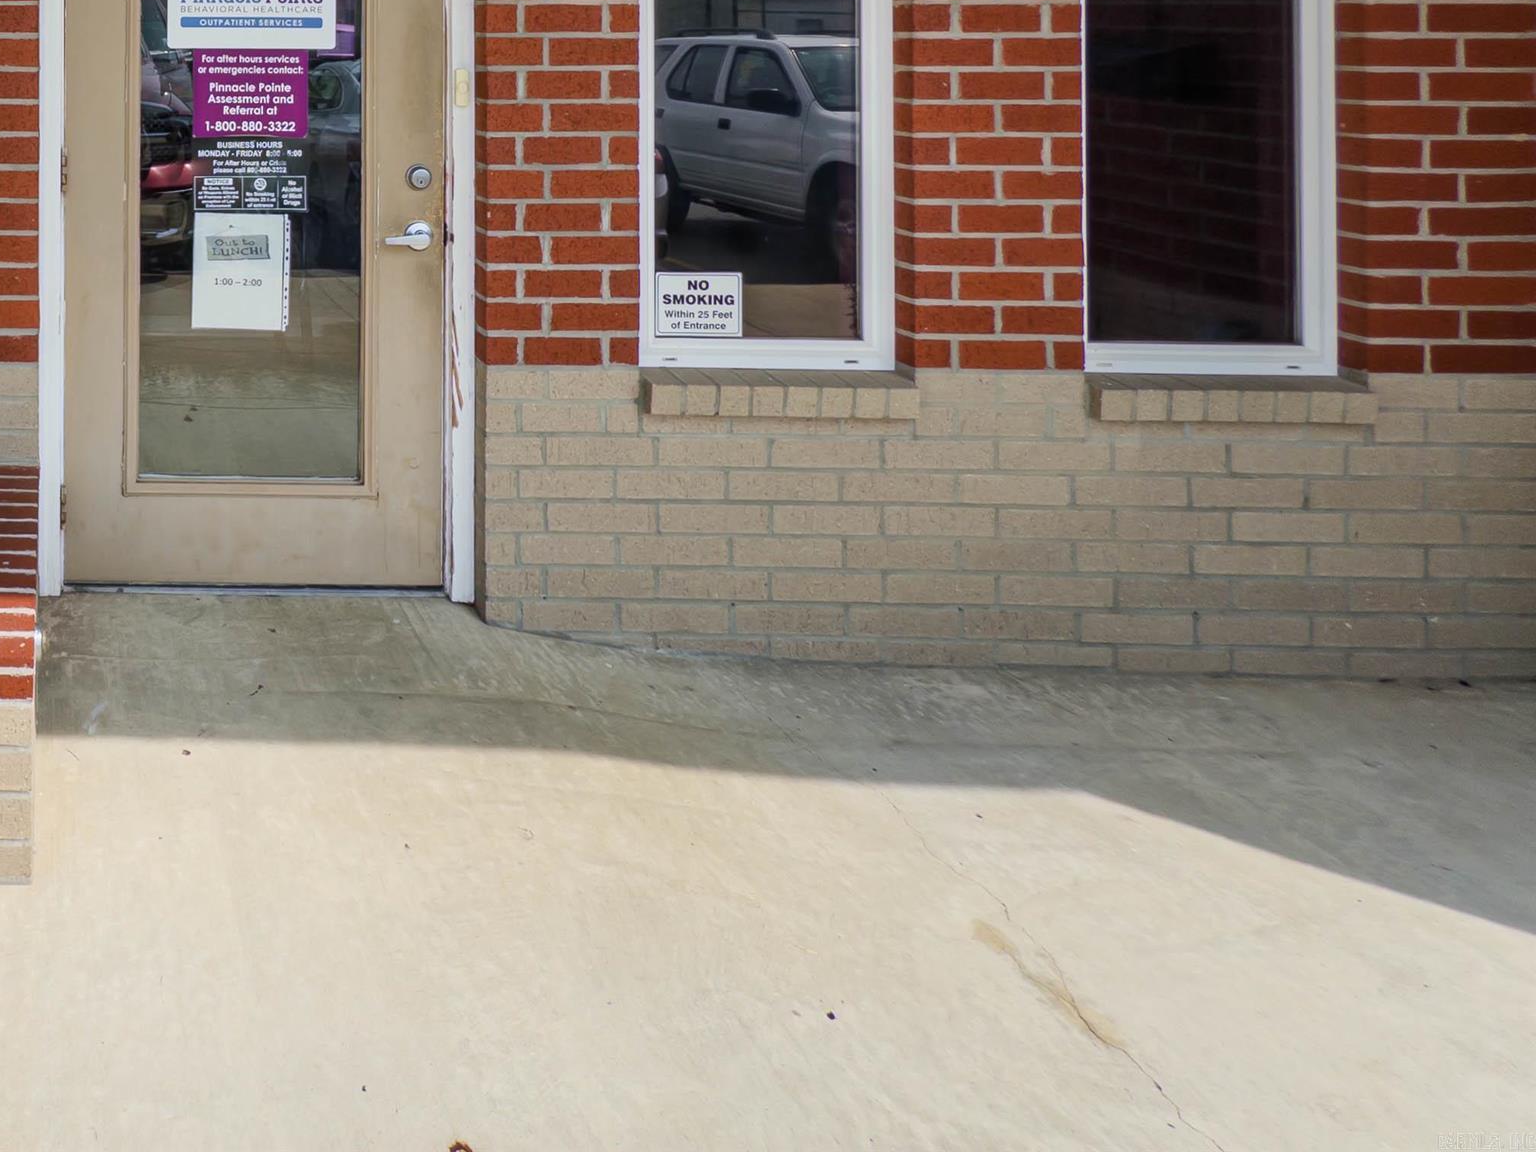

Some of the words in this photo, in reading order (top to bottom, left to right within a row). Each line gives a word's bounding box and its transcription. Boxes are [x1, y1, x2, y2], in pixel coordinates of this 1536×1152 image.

[180, 5, 248, 13] BEHAVIORAL
[253, 6, 323, 14] HEALTHCARE
[201, 54, 214, 63] For
[216, 54, 238, 63] after
[239, 55, 263, 63] hours
[264, 55, 300, 64] services
[208, 65, 266, 76] emergencies
[267, 66, 304, 74] contact:
[209, 82, 256, 92] Pinnacle
[258, 82, 292, 92] Pointe
[207, 94, 270, 104] Assessment
[272, 94, 294, 104] and
[223, 105, 264, 115] Referral
[266, 106, 277, 115] at
[205, 120, 296, 132] 1-800-880-3322
[216, 141, 255, 149] BUSINESS
[256, 141, 283, 149] HOURS
[215, 238, 239, 246] Out
[215, 278, 233, 286] 1:00
[242, 278, 262, 286] 2:00
[687, 280, 710, 291] NO
[662, 294, 735, 305] SMOKING
[664, 310, 695, 319] Within
[697, 310, 710, 319] 25
[712, 310, 733, 319] Feet
[670, 321, 681, 329] of
[683, 321, 727, 330] Entrance
